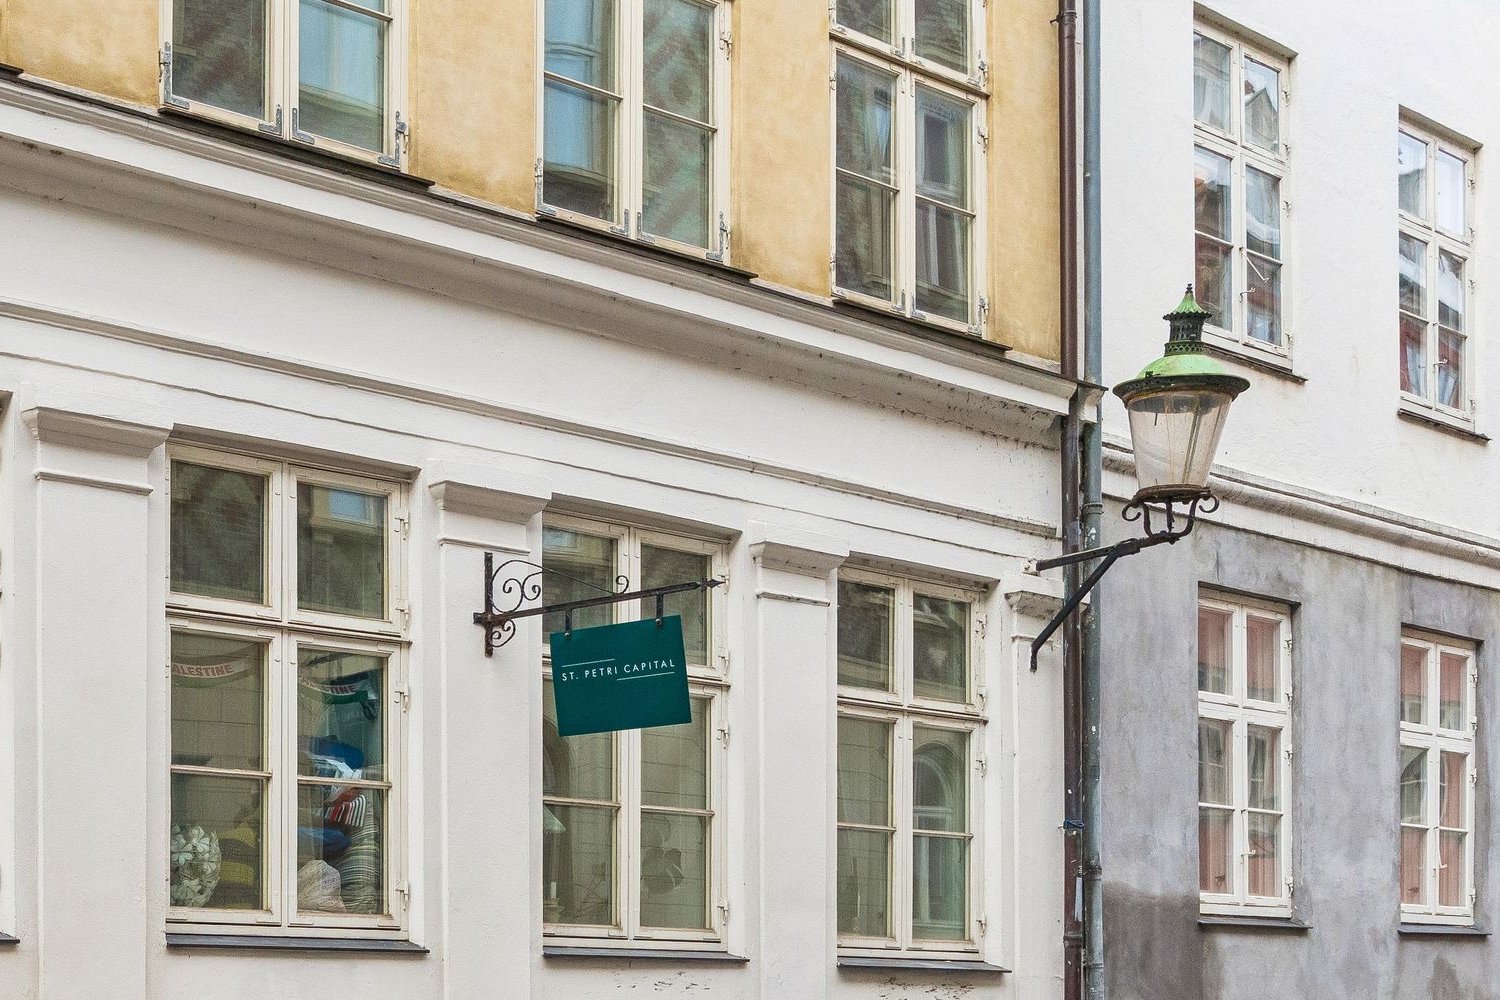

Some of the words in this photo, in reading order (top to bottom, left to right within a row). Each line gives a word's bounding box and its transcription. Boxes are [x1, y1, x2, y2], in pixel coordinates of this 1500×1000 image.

[562, 672, 579, 682] ST.
[585, 666, 618, 679] PETRI
[623, 659, 675, 674] CAPITAL
